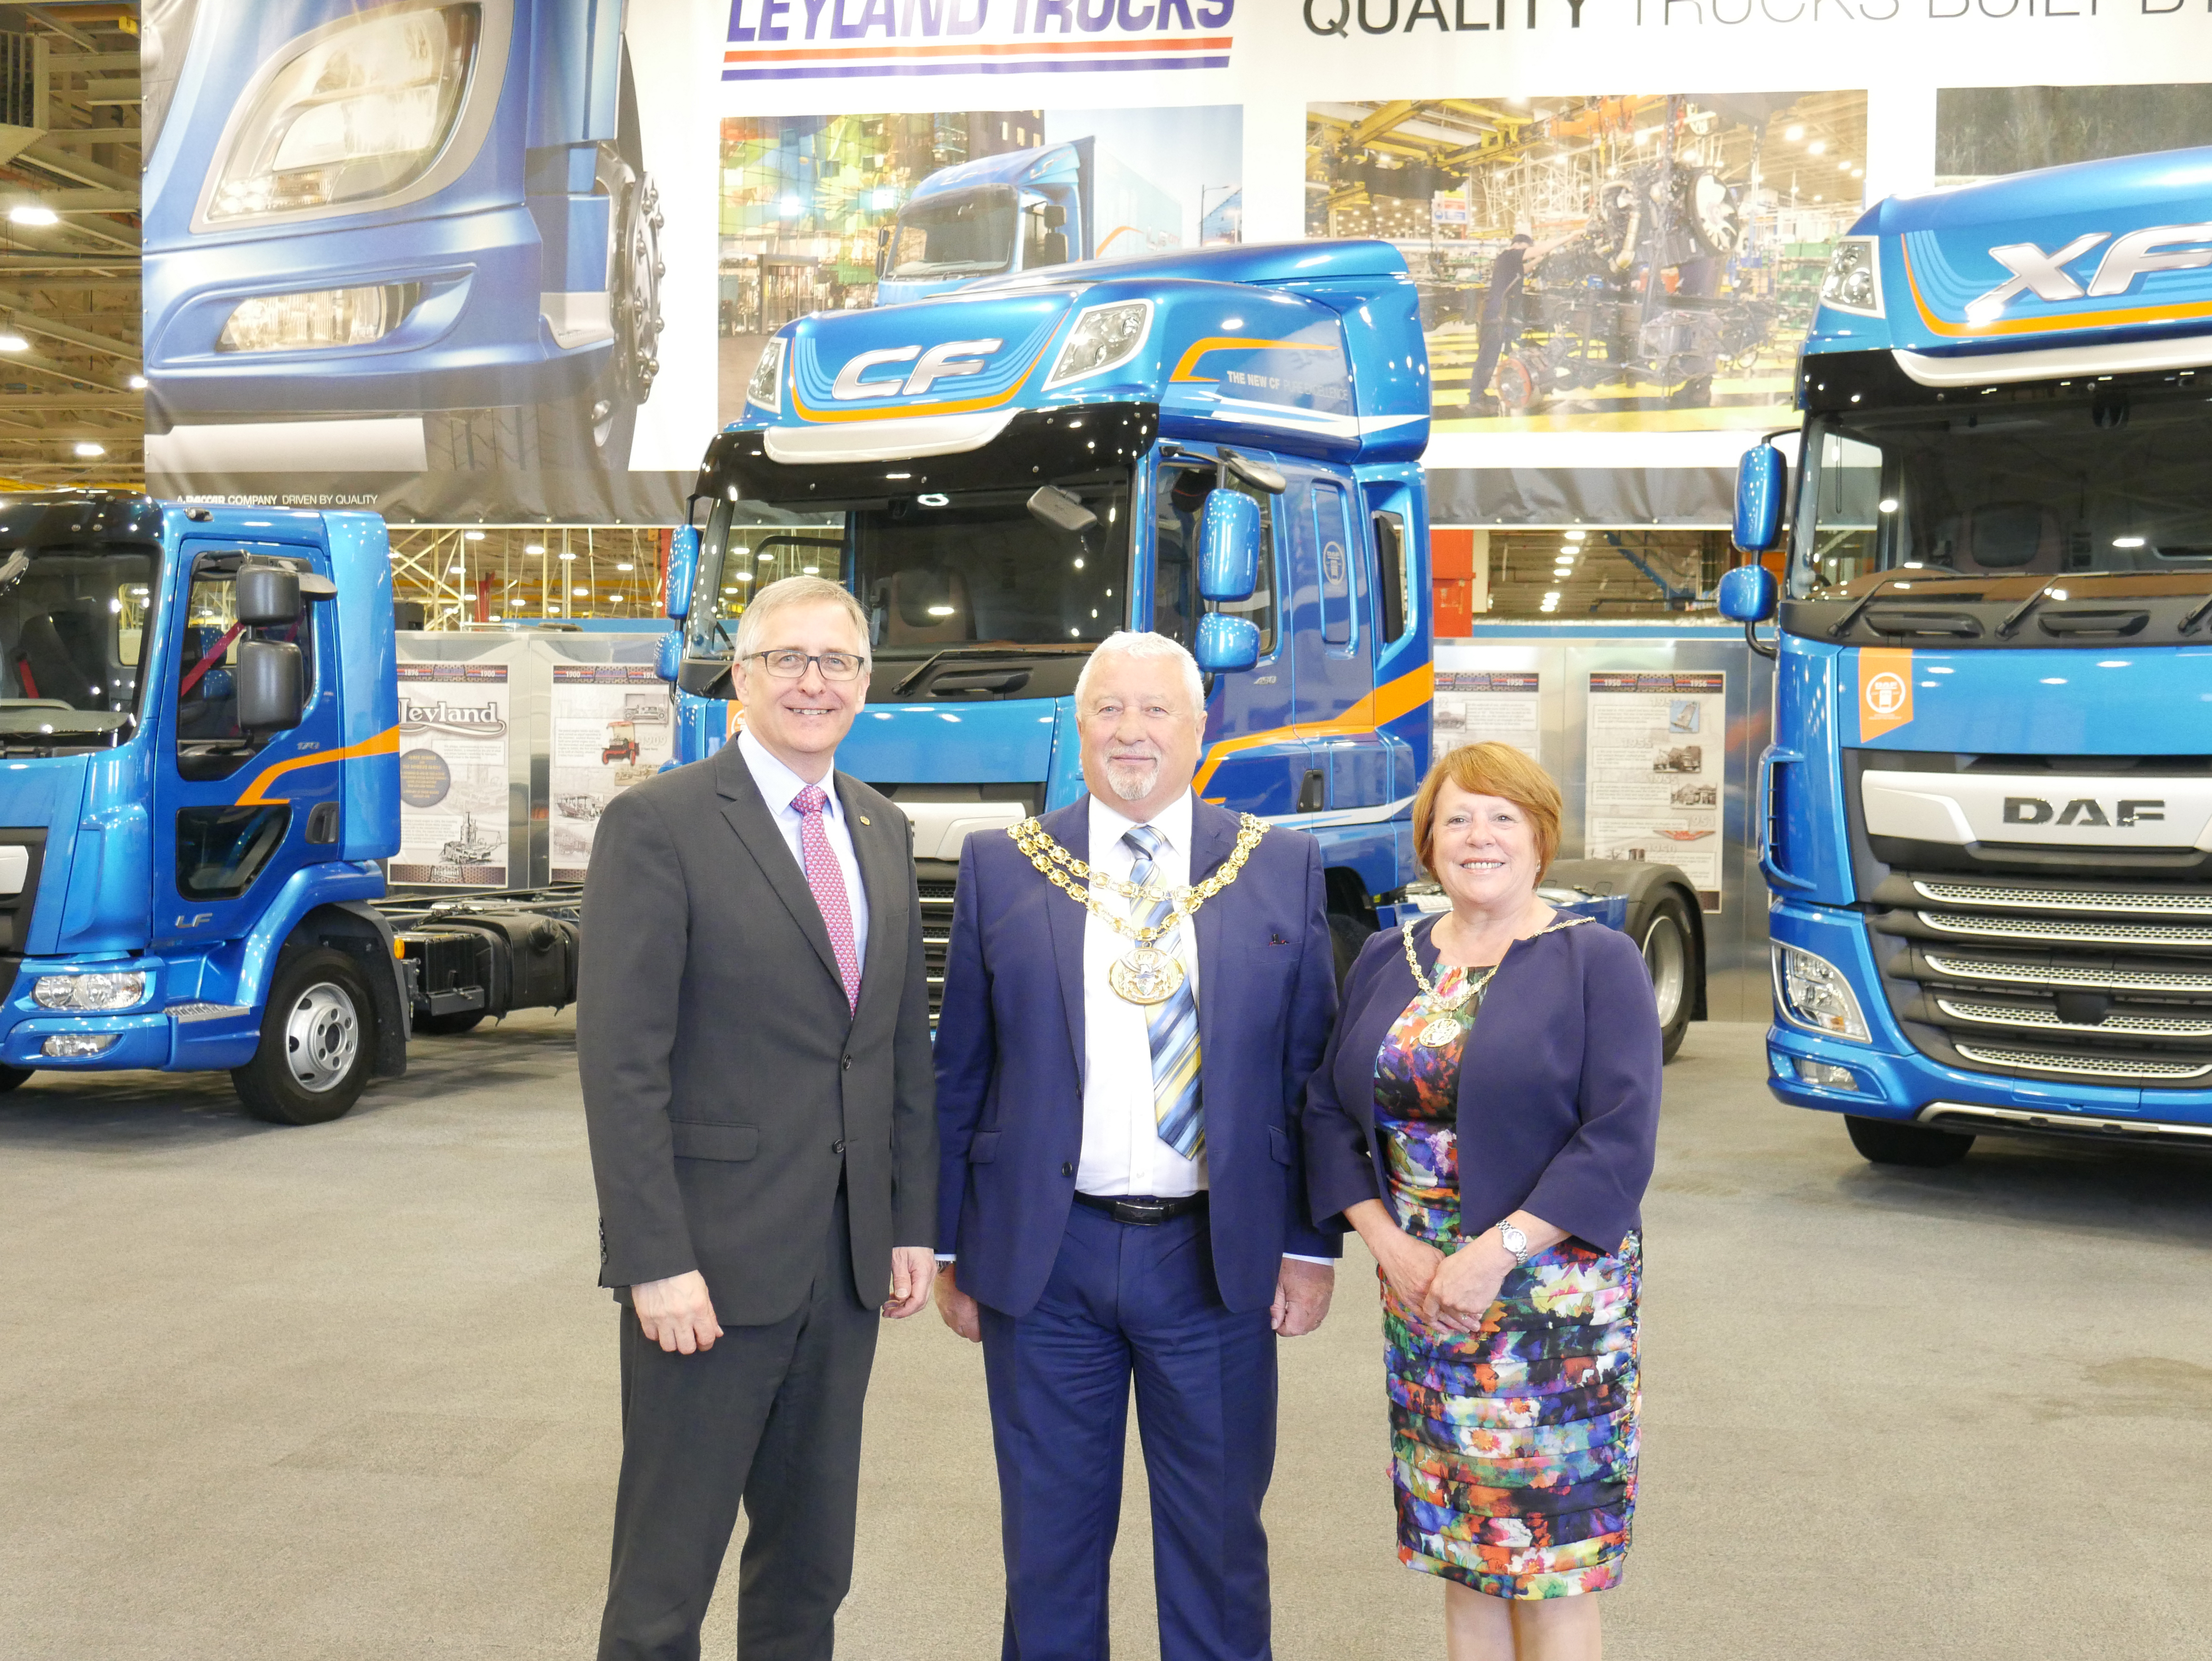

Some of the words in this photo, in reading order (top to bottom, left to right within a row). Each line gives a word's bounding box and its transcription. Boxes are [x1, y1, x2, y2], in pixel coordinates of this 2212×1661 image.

[726, 0, 989, 42] LEYLAND
[1013, 0, 1235, 34] TRUCKS
[1964, 222, 2212, 321] XF
[832, 338, 1003, 400] CF
[1226, 370, 1246, 385] THE
[1247, 373, 1267, 388] NEW
[1269, 377, 1280, 389] CF
[227, 494, 277, 505] COMPANY
[282, 494, 317, 504] DRIVEN
[319, 494, 333, 504] BY
[335, 494, 378, 504] QUALITY
[399, 697, 506, 737] Leyland
[639, 736, 667, 746] 1909
[2003, 797, 2166, 827] DAF
[175, 912, 213, 929] LF
